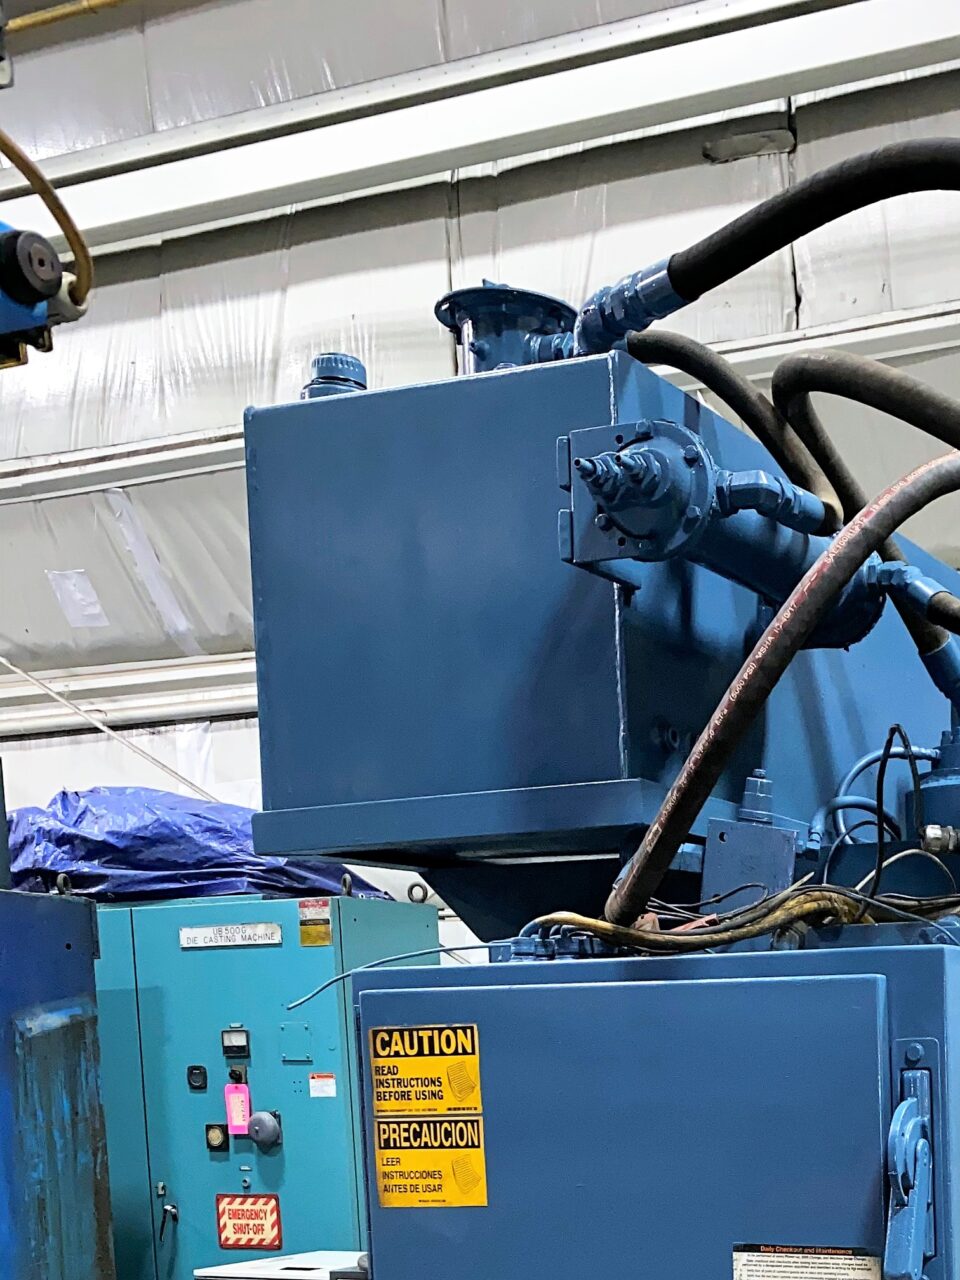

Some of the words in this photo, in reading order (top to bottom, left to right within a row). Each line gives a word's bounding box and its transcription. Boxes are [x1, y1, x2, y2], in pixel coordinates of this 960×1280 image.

[755, 636, 775, 659] MSHA
[186, 936, 199, 945] DIE
[203, 935, 237, 944] CASTING
[240, 932, 276, 942] MACHINE
[375, 1028, 473, 1057] CAUTION
[375, 1065, 399, 1076] READ
[375, 1077, 443, 1089] INSTRUCTIONS
[376, 1090, 412, 1101] BEFORE
[414, 1089, 444, 1100] USING
[379, 1122, 479, 1148] PRECAUCION
[381, 1157, 401, 1167] LEER
[382, 1170, 443, 1180] INSTRUCCIONES
[383, 1184, 408, 1193] ANTES
[409, 1184, 419, 1193] DE
[421, 1184, 443, 1193] USAR
[227, 1208, 268, 1220] EMERGENCY
[232, 1223, 265, 1235] SHUT-OFF
